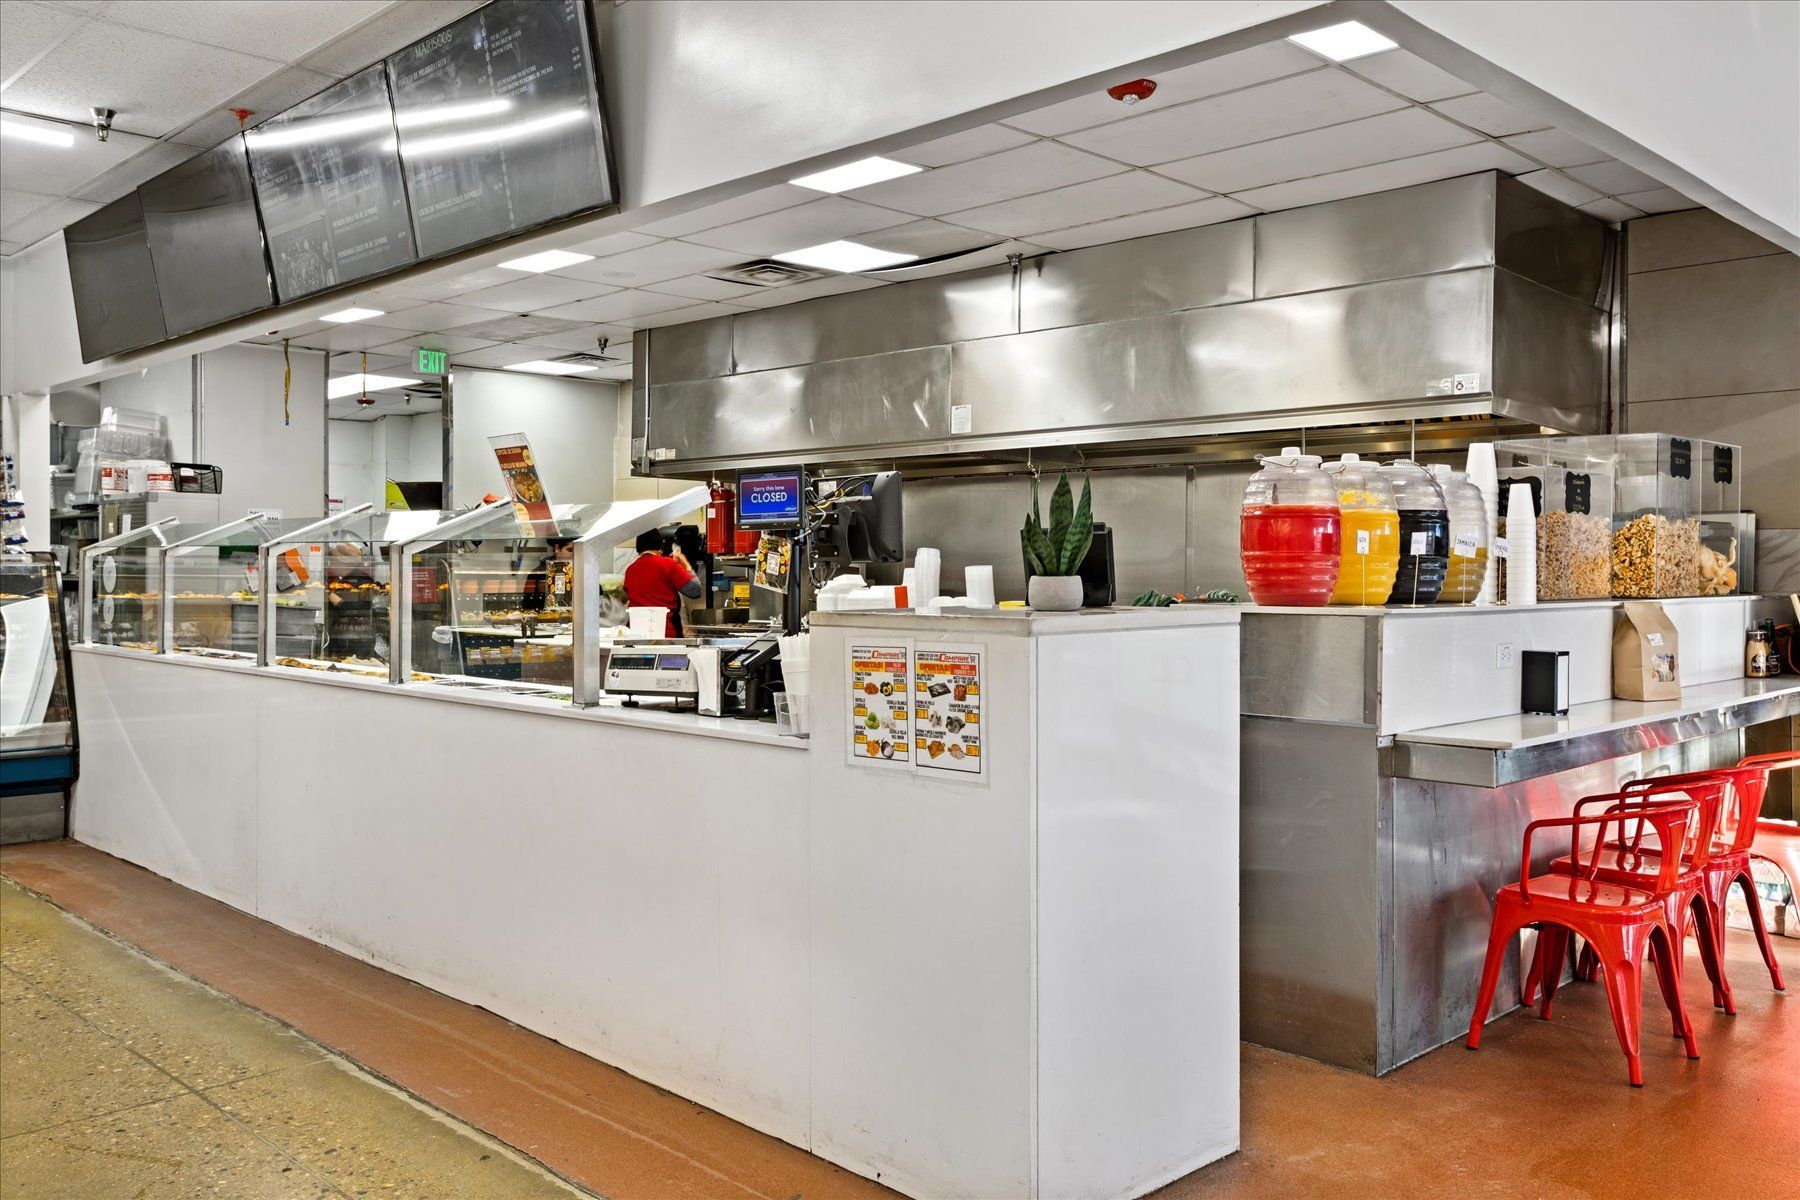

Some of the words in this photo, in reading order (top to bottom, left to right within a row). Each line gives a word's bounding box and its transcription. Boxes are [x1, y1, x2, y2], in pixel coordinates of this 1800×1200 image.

[414, 30, 453, 59] MARISCOS
[419, 350, 447, 375] EXIT
[751, 492, 788, 503] CLOSED
